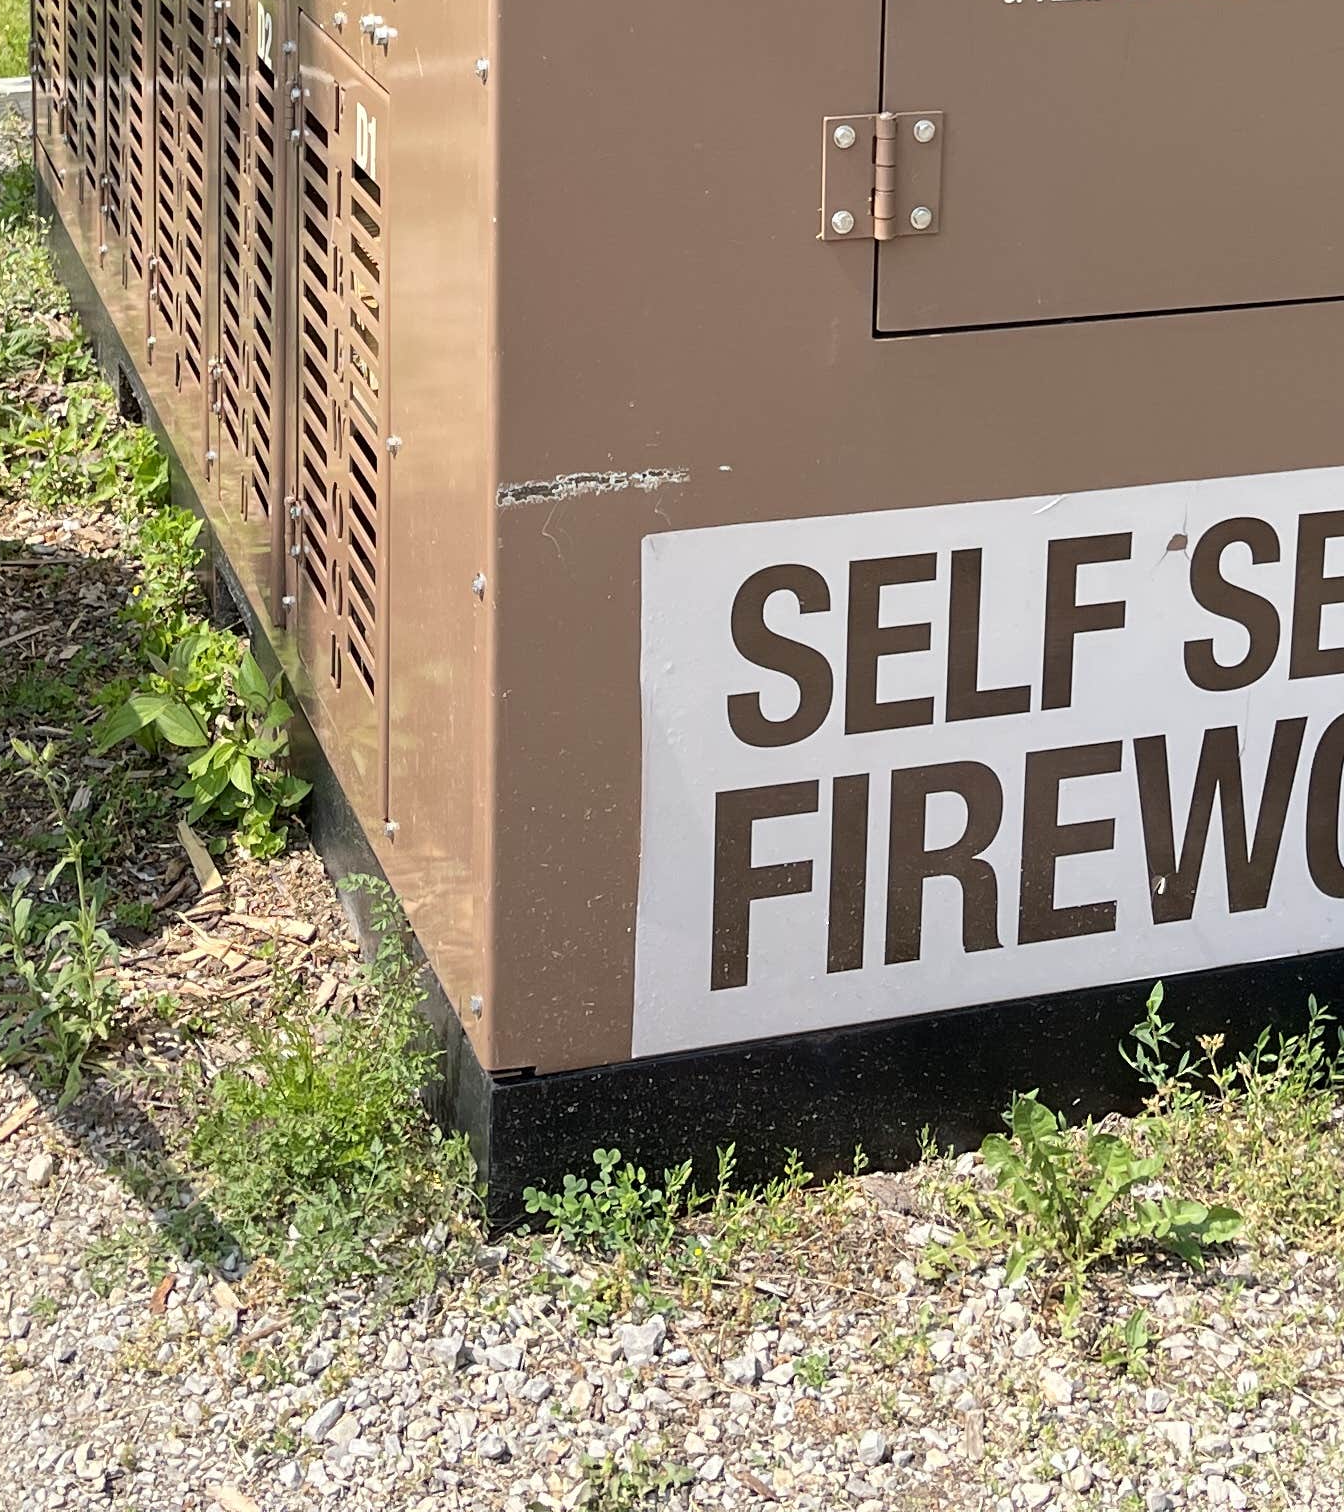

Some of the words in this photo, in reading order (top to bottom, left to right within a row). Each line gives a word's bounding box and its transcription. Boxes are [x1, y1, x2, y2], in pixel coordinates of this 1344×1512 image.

[257, 1, 272, 71] D2
[356, 102, 377, 182] D1
[330, 80, 347, 694] FIREWOOD
[727, 532, 1132, 749] SELF
